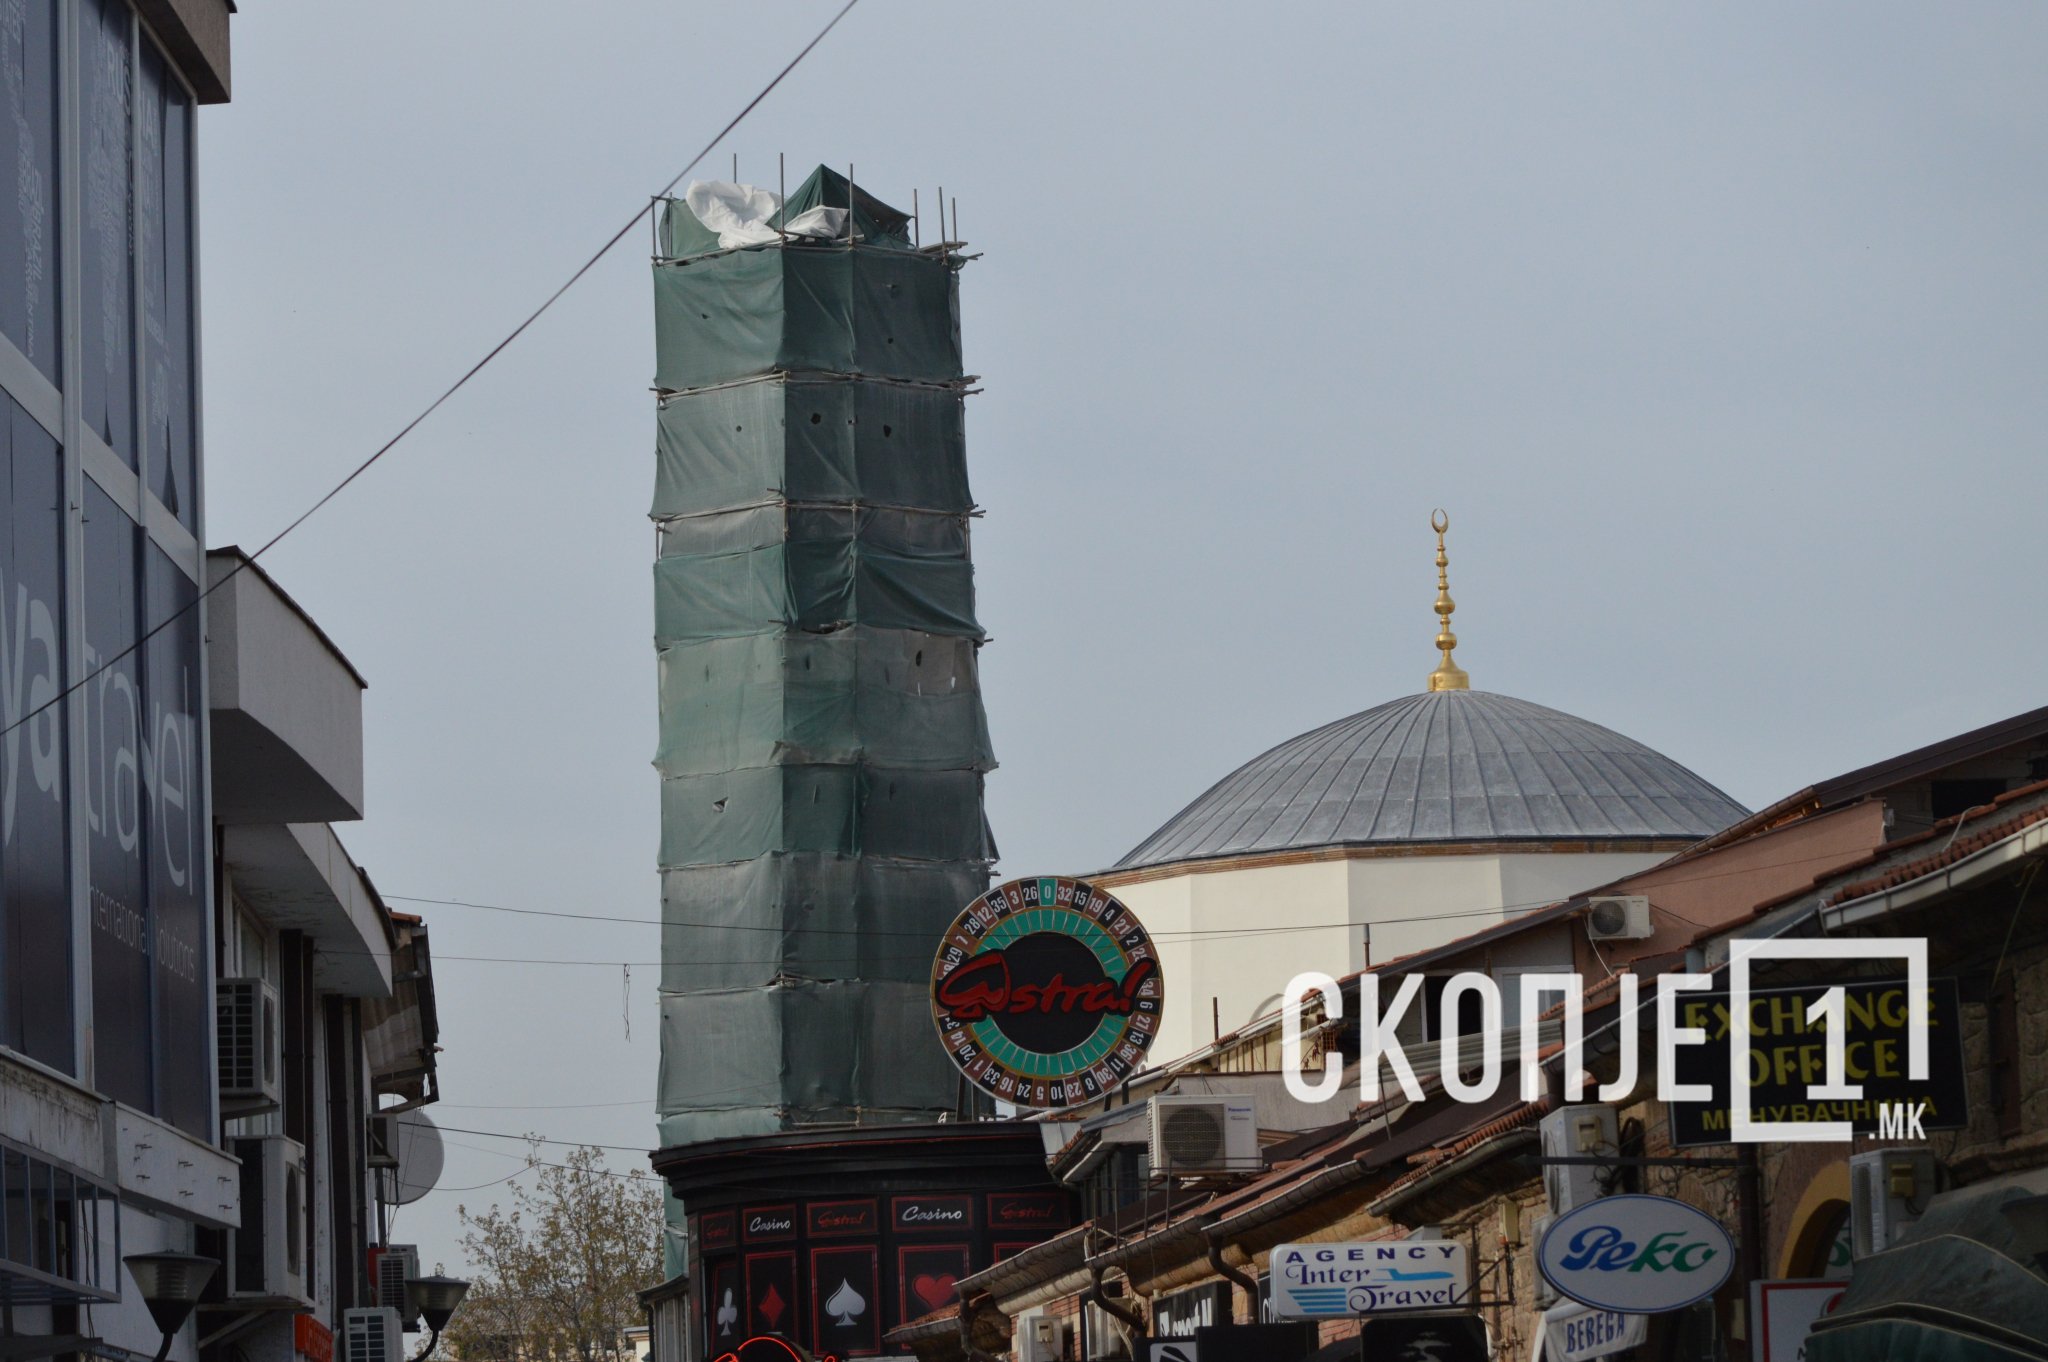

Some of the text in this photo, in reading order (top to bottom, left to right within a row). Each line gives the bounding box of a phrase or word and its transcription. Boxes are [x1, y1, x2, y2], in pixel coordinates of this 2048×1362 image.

[1008, 889, 1019, 904] 3
[1022, 885, 1037, 900] 26
[1044, 885, 1051, 898] 0
[1058, 886, 1072, 901] 32
[1073, 889, 1088, 905] 15
[989, 896, 1005, 912] 35
[1089, 897, 1103, 911] 19
[90, 884, 149, 956] nternational
[976, 906, 991, 921] 12
[1104, 908, 1115, 920] 4
[963, 917, 979, 934] 28
[1115, 918, 1130, 933] 21
[1126, 934, 1140, 946] 2
[947, 947, 962, 961] 29
[938, 952, 1153, 1018] Astra!
[1140, 981, 1153, 995] 34
[1139, 1001, 1153, 1009] 6
[1135, 1014, 1151, 1030] 27
[1685, 988, 1939, 1041] EXCHANGE
[944, 1015, 959, 1030] 3
[951, 1031, 966, 1045] 14
[1129, 1031, 1144, 1044] 13
[959, 1044, 975, 1060] 20
[1120, 1044, 1136, 1059] 36
[972, 1059, 984, 1070] 1
[1110, 1058, 1123, 1071] 11
[1735, 1039, 1900, 1087] OFFICE
[984, 1068, 999, 1084] 33
[1095, 1067, 1112, 1083] 30
[999, 1077, 1013, 1092] 16
[1015, 1082, 1030, 1098] 24
[1066, 1081, 1082, 1097] 23
[1084, 1076, 1095, 1090] 8
[1036, 1086, 1043, 1099] 5
[1051, 1085, 1061, 1099] 10
[902, 1205, 962, 1221] Casino
[749, 1216, 791, 1233] Casino
[1286, 1247, 1456, 1263] AGENCY
[1559, 1225, 1718, 1272] Peko
[1286, 1264, 1371, 1285] Inter
[1349, 1283, 1458, 1311] Travel
